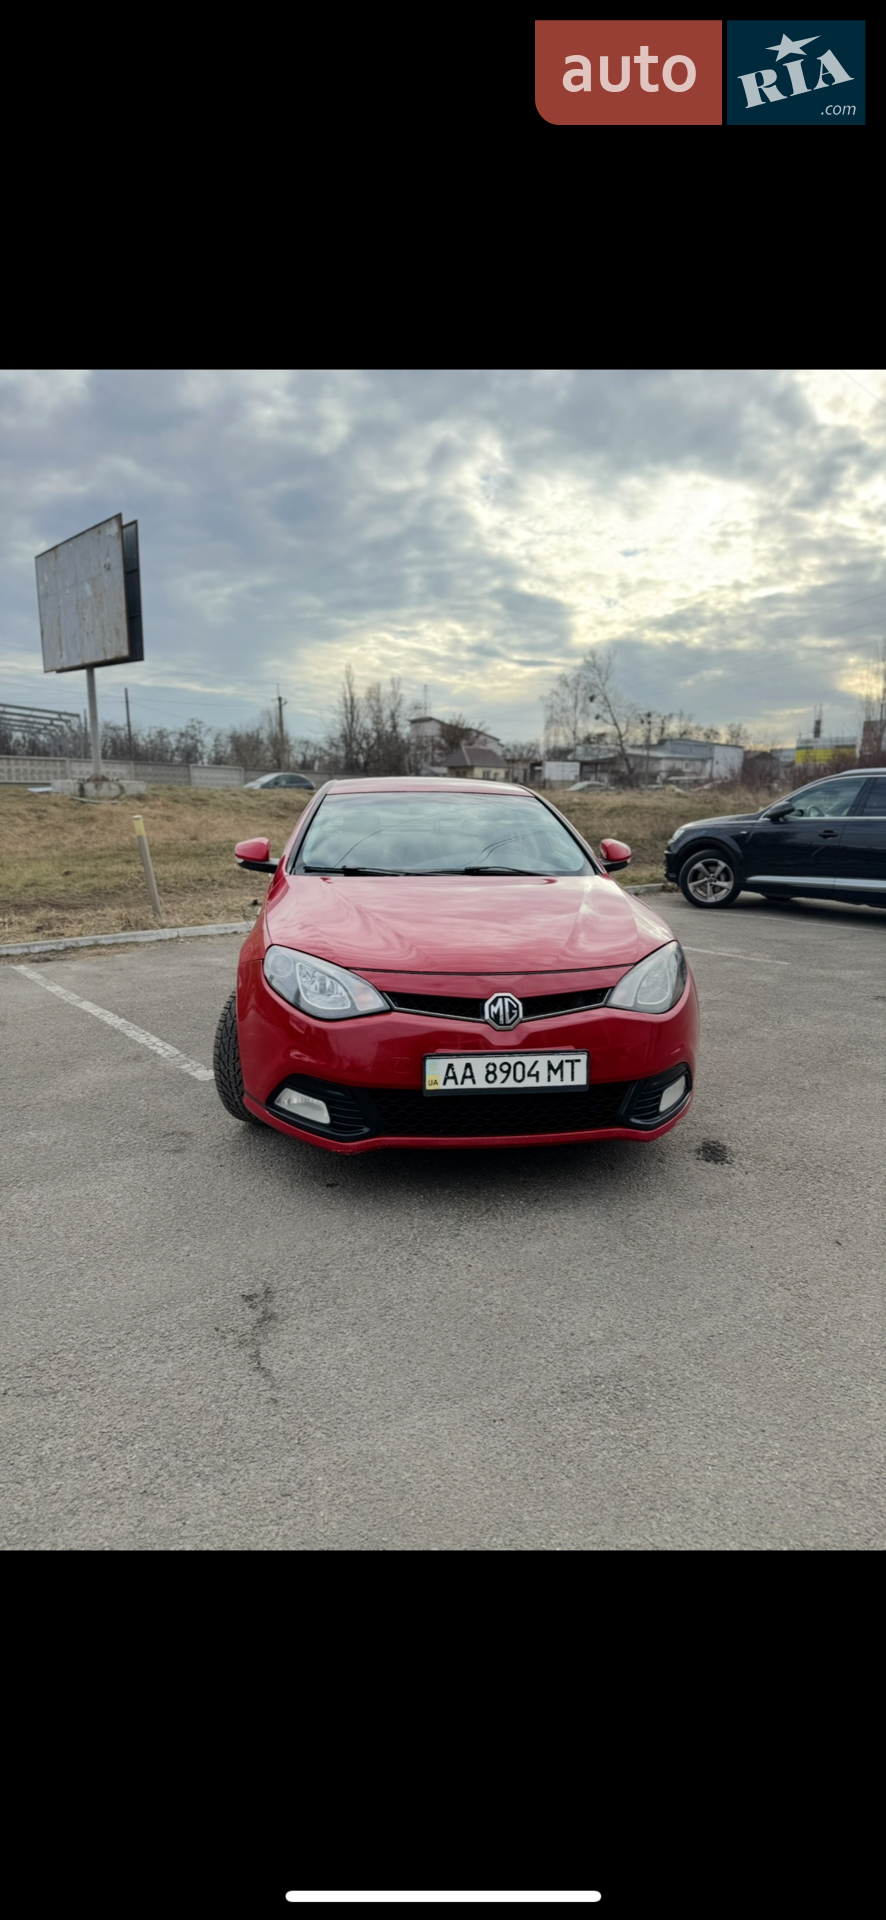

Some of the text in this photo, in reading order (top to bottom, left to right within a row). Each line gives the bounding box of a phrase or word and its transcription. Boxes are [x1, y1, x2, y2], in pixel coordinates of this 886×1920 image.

[490, 997, 518, 1024] MG
[442, 1058, 582, 1086] AA 8904 MT
